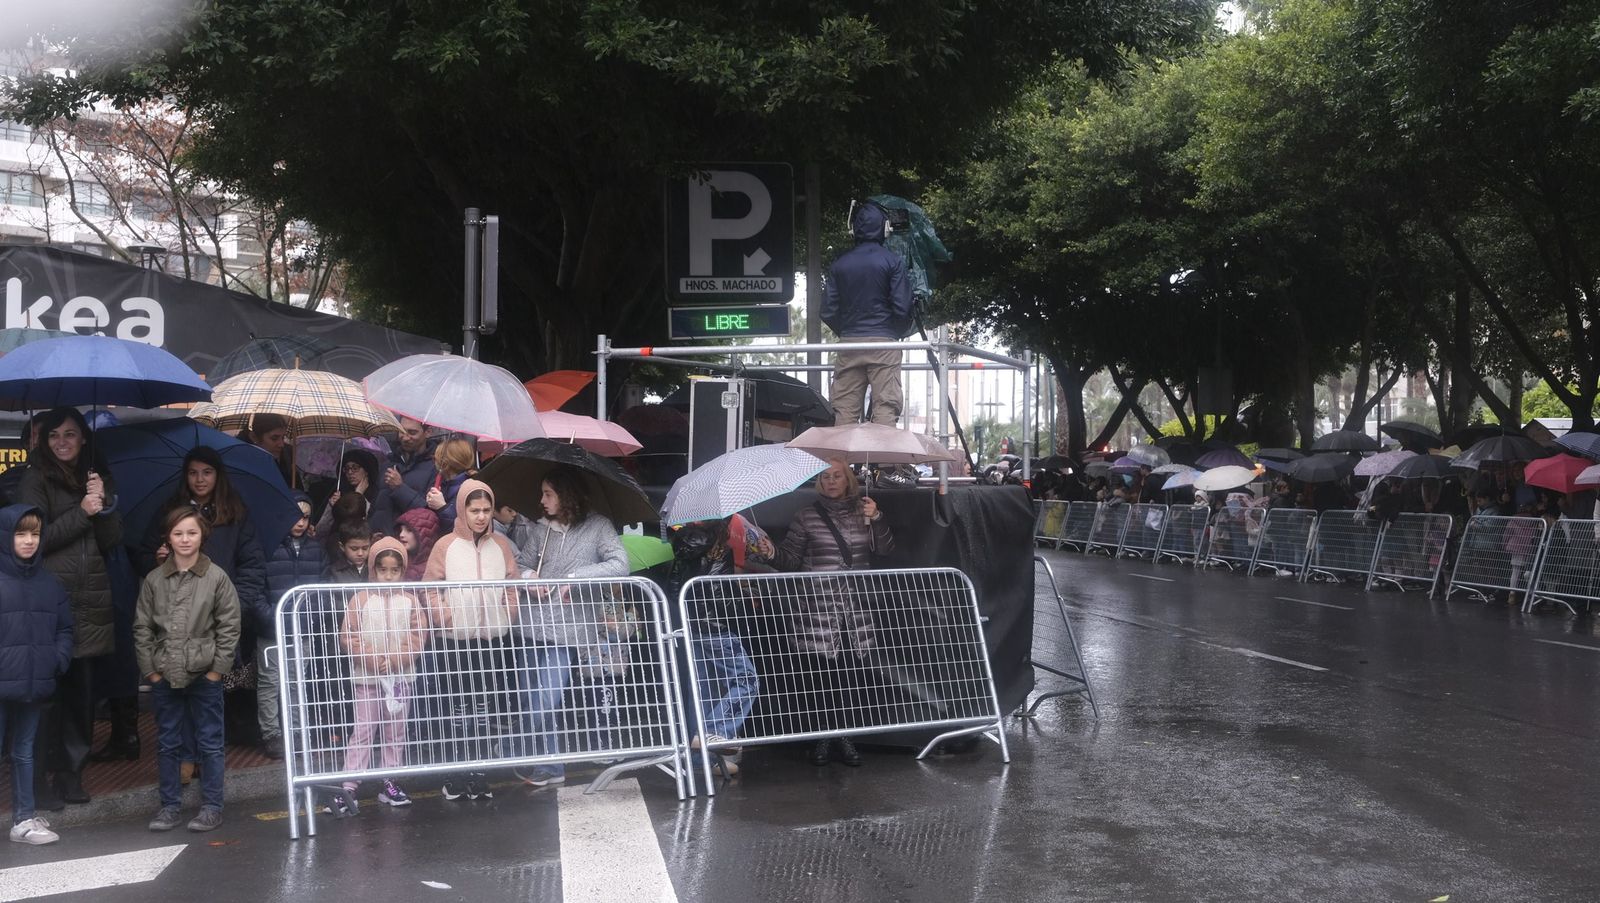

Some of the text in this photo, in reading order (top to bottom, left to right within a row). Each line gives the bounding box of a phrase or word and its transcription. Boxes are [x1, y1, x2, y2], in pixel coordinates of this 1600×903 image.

[688, 170, 772, 276] P
[685, 279, 776, 291] HNOS. MACHADO
[6, 277, 165, 348] kea
[705, 314, 750, 330] LIBRE
